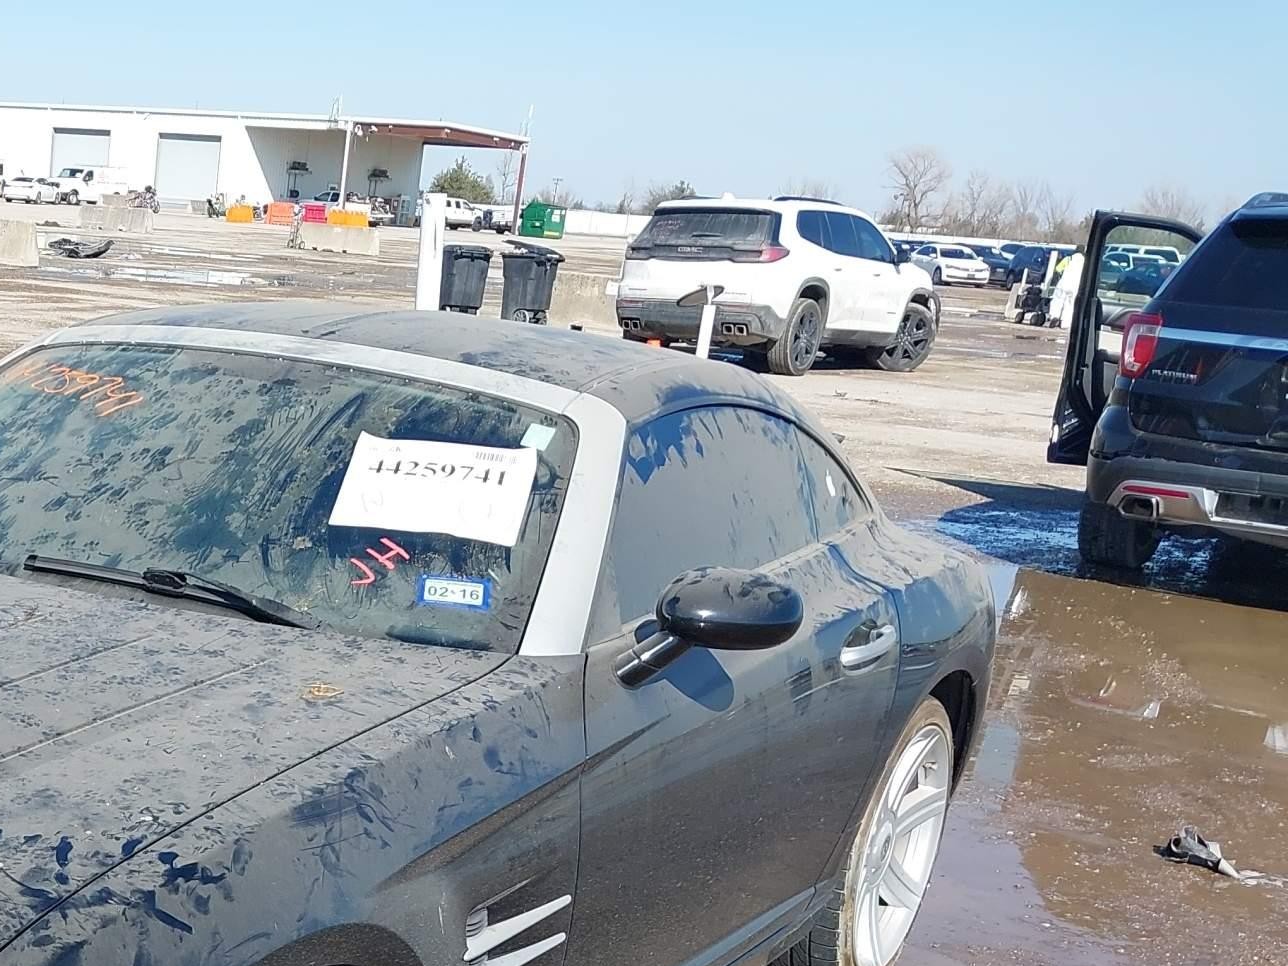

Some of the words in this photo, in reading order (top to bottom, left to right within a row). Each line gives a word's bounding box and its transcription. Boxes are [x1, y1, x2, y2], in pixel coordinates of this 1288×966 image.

[1151, 369, 1199, 380] PLATINUM
[368, 459, 506, 486] 44259741
[427, 585, 449, 598] 02
[459, 588, 480, 601] 16
